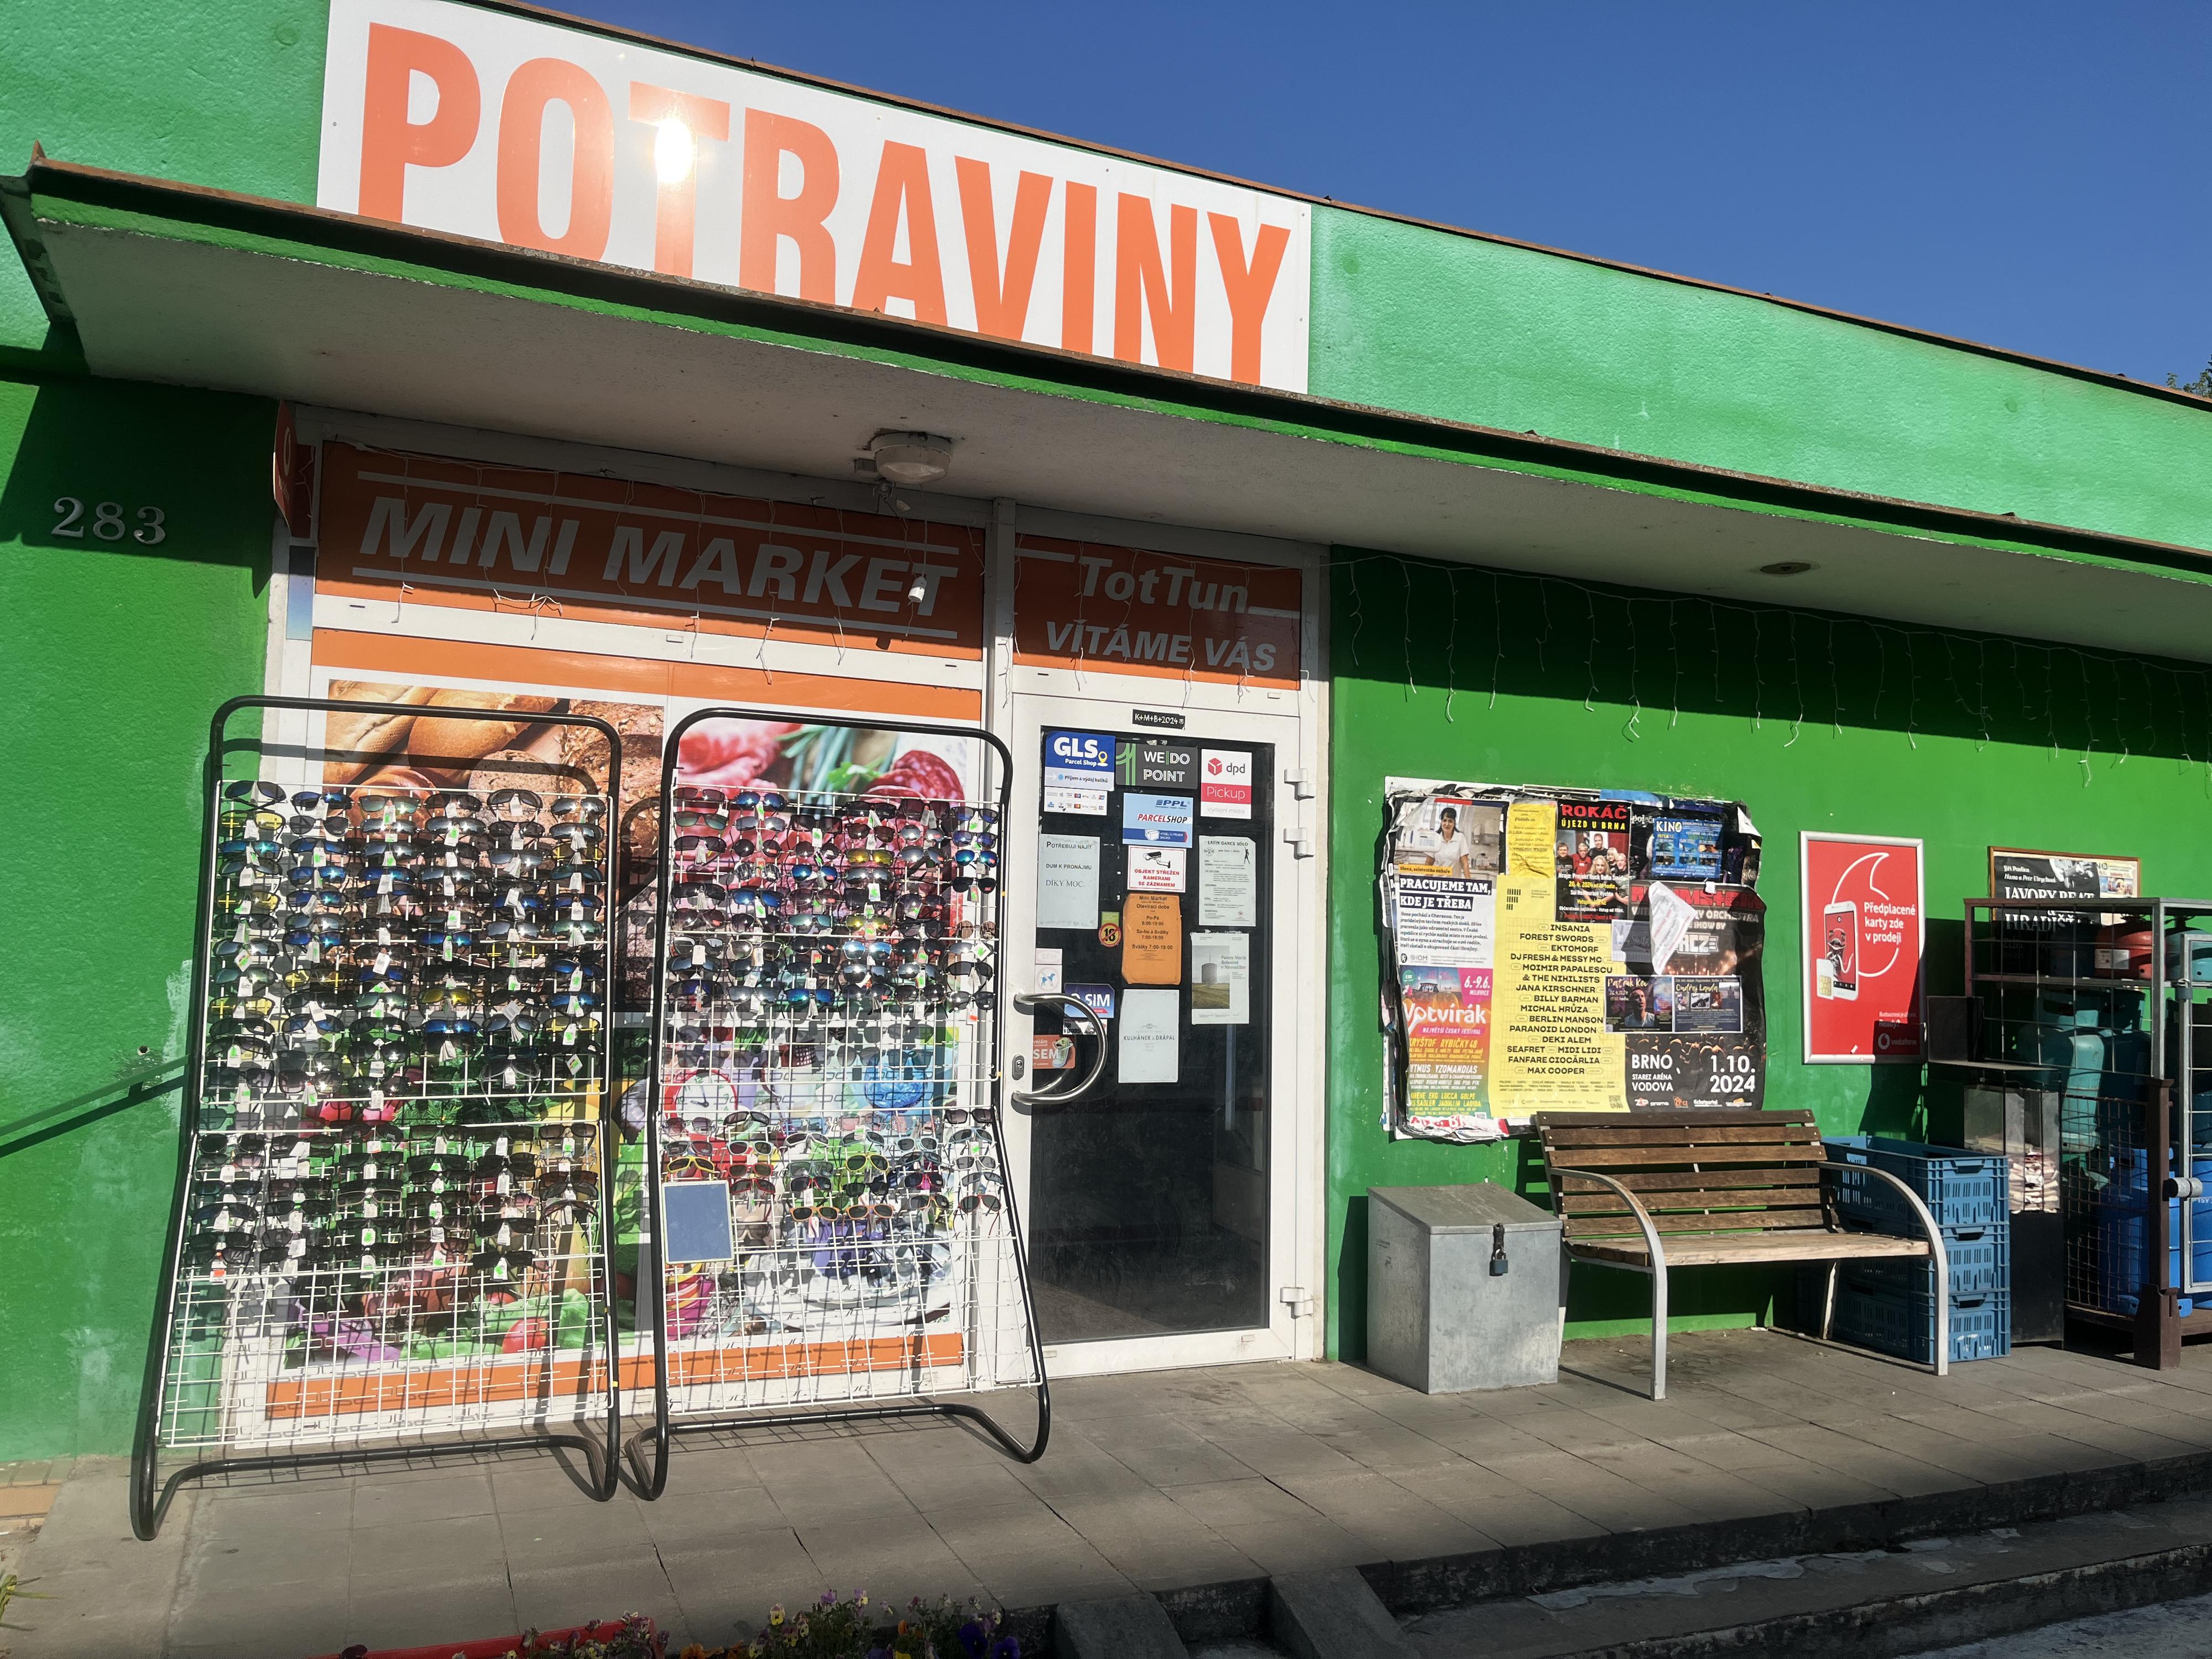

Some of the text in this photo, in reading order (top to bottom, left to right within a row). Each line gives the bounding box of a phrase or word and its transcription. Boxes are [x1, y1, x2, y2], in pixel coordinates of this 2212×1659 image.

[358, 21, 1291, 385] POTRAVINY
[51, 496, 166, 545] 283
[359, 497, 958, 617] MINI MARKET
[1081, 555, 1250, 614] TotTun
[1047, 619, 1277, 671] VÍTÁME VÁS
[1135, 713, 1178, 724] K+M+B+2024
[1054, 737, 1098, 758] GLS
[1143, 769, 1185, 782] POINT
[1227, 763, 1245, 775] dpd
[1207, 786, 1245, 799] Pickup
[1138, 814, 1187, 823] PARCELSHOP
[1562, 805, 1627, 820] ROKÁČ
[1562, 818, 1587, 828] ÚJEZD
[1656, 821, 1682, 833] KINO
[1400, 878, 1491, 895] PRACUJEME TAM,
[1400, 895, 1472, 909] KDE JE TŘEBA
[1864, 901, 1916, 916] Předplacené
[1706, 910, 1759, 923] ORCHESTRA
[1865, 916, 1903, 930] karty zde
[1104, 928, 1116, 942] 18
[1865, 931, 1901, 945] v prodeji
[1561, 965, 1613, 973] PAPALESCU
[1464, 975, 1490, 988] 6.-9.6.
[1551, 975, 1600, 983] NIHILISTS
[1085, 994, 1110, 1006] SIM
[1559, 1003, 1588, 1013] HRŮZA
[1440, 1037, 1468, 1048] RYBIČKY
[1033, 1049, 1057, 1059] SEM
[1410, 1063, 1478, 1073] YTMUS YZOMANDIAS
[1631, 1054, 1672, 1070] BRNO
[1710, 1055, 1756, 1073] 1.10.
[1632, 1082, 1673, 1092] VODOVA
[1710, 1074, 1755, 1093] 2024
